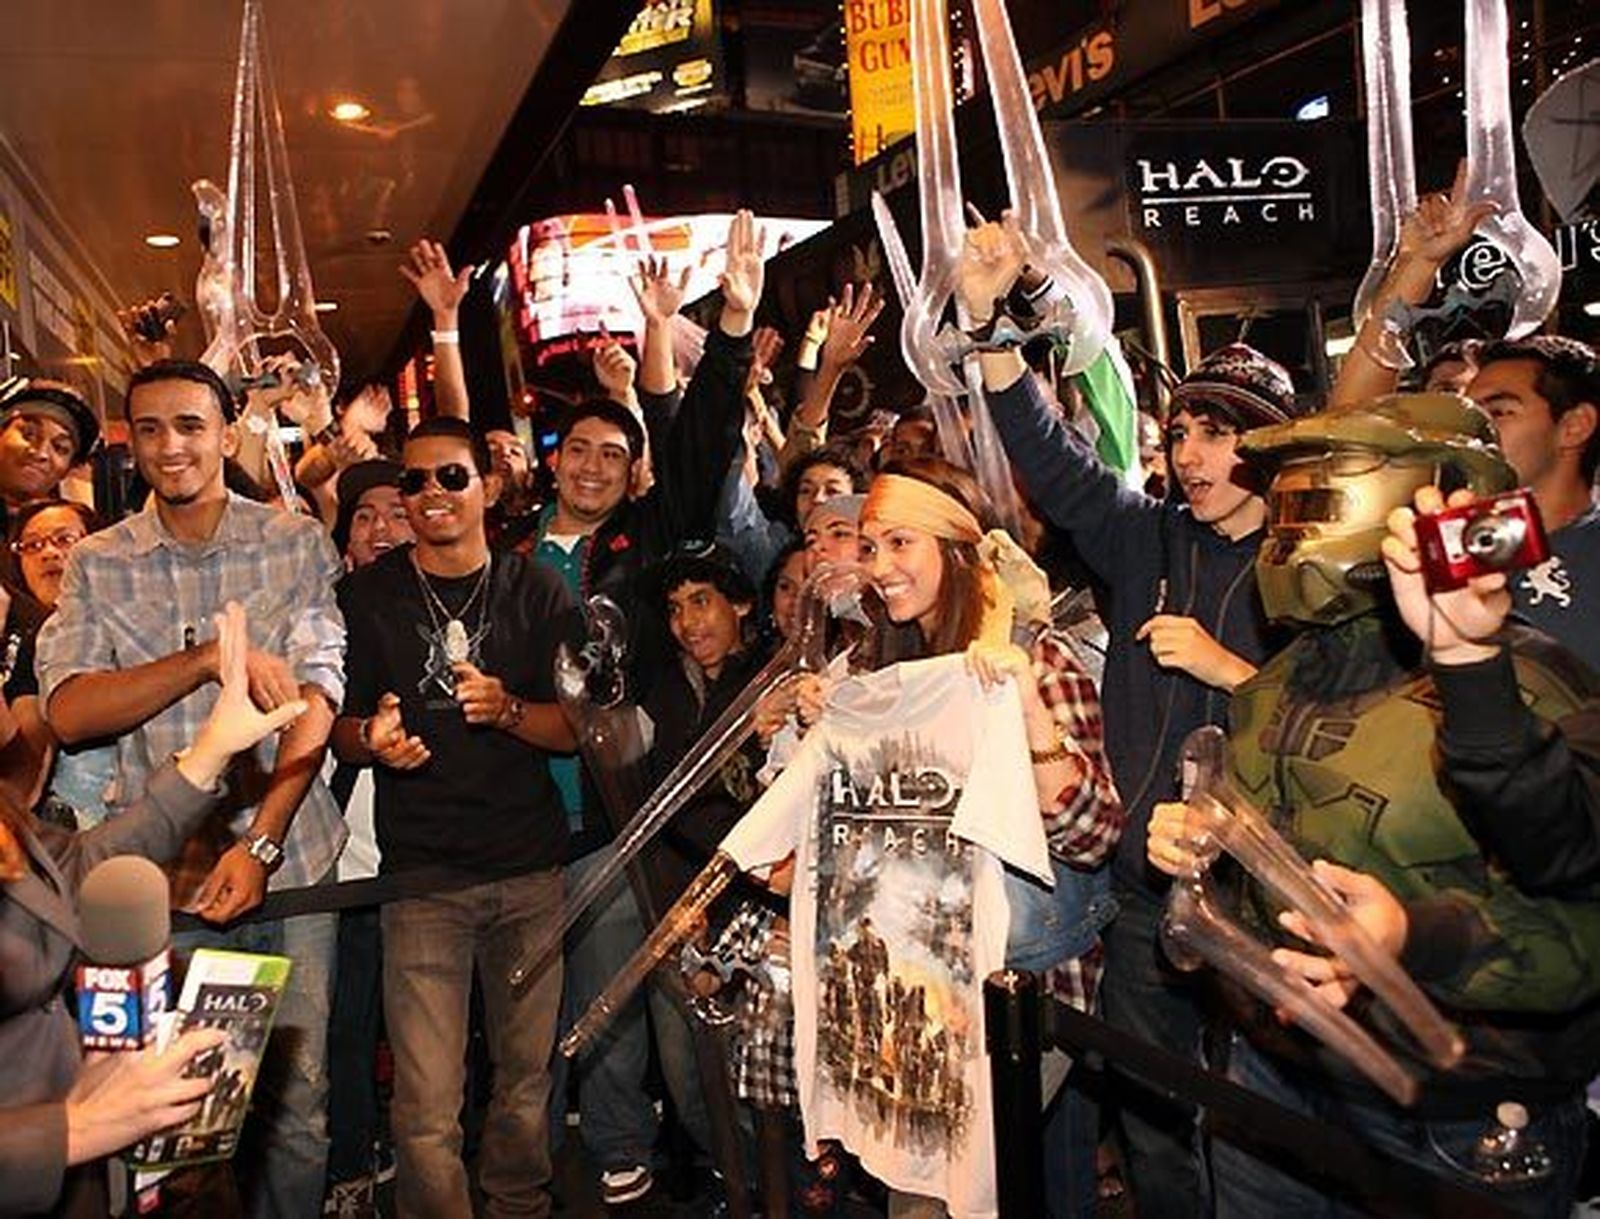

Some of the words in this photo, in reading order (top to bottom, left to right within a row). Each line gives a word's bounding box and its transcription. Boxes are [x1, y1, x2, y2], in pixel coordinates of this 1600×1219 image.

[850, 0, 911, 34] BUB
[1137, 156, 1310, 192] HALO
[1143, 203, 1315, 228] REACH
[832, 770, 955, 809] HALO
[84, 967, 131, 991] FOX
[93, 992, 128, 1036] 5
[203, 993, 268, 1012] HALO
